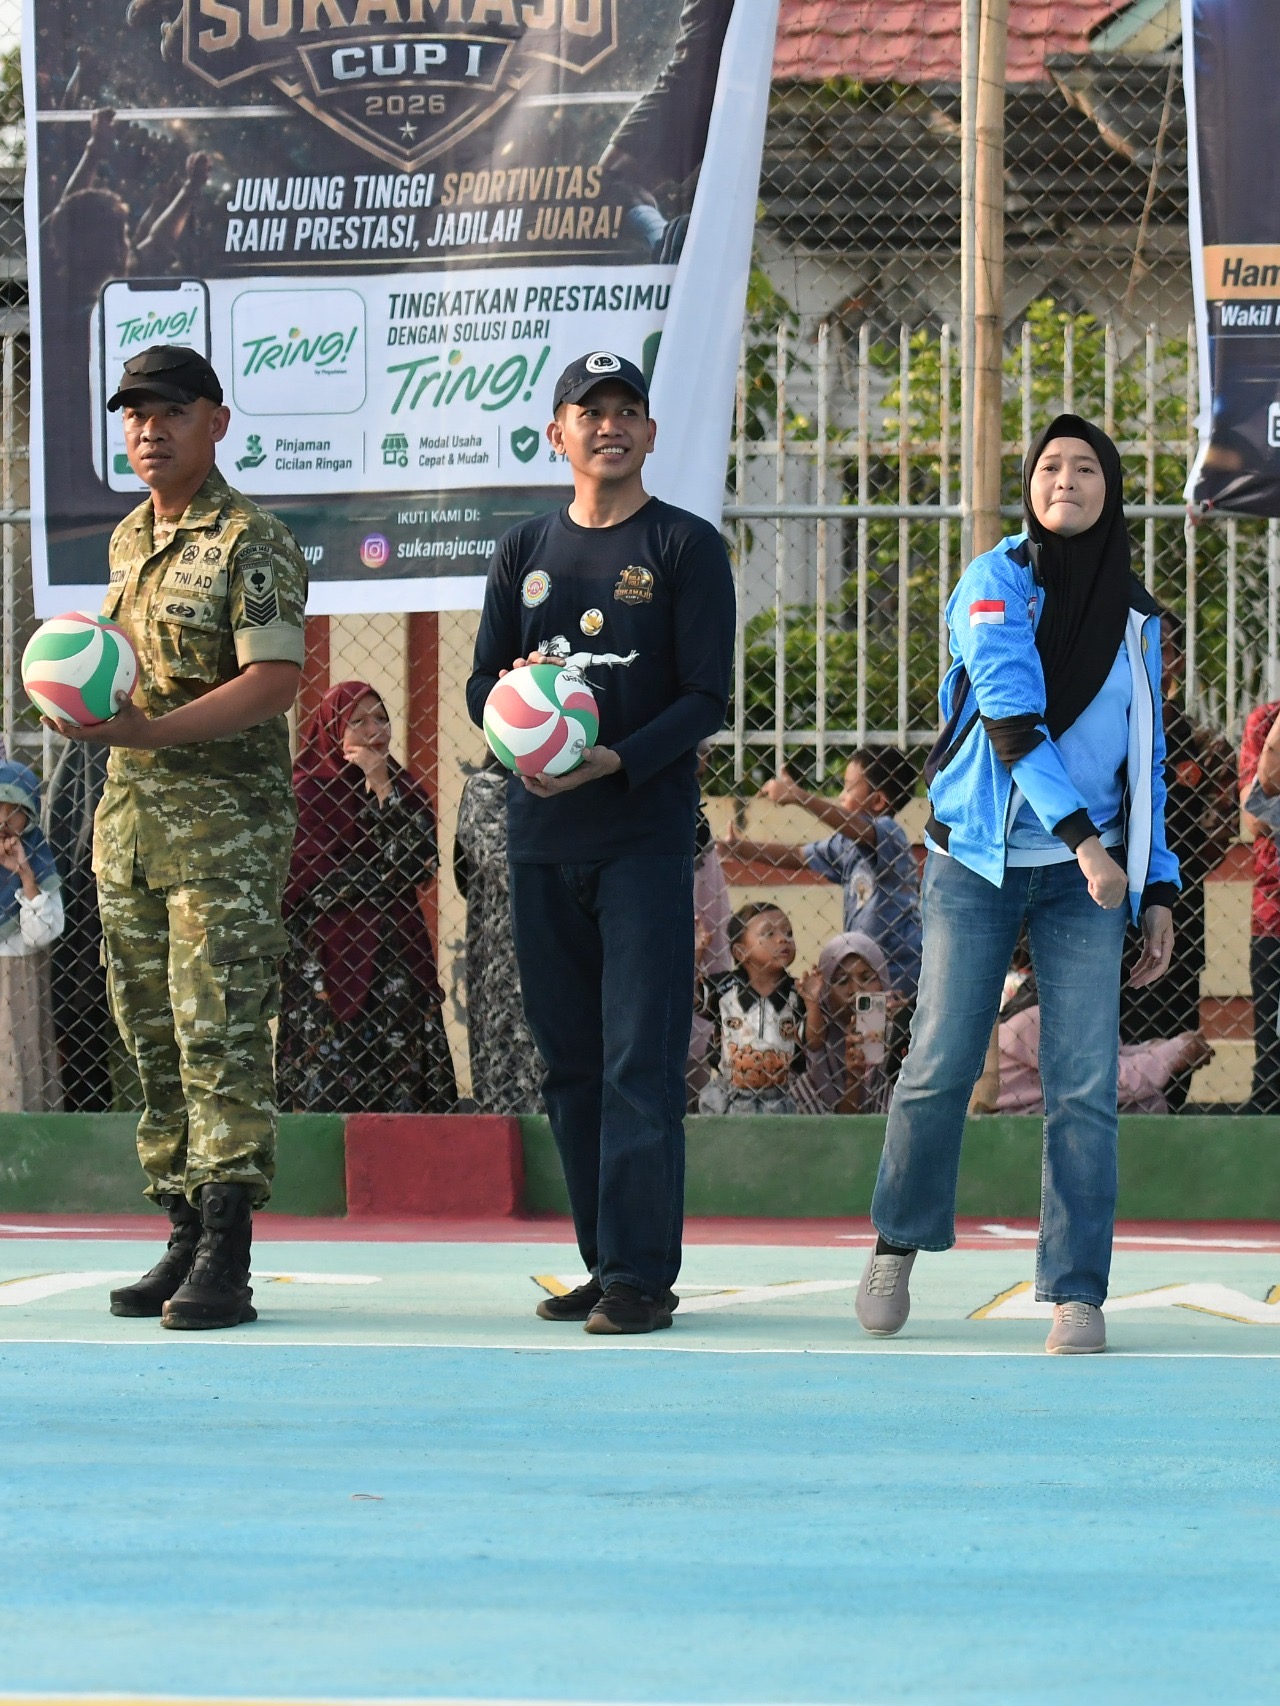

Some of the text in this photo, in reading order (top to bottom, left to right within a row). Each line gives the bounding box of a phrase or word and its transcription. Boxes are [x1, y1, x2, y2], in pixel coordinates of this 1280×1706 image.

[331, 43, 482, 80] CUP I
[365, 94, 445, 116] 2026
[226, 164, 603, 213] JUNJUNG TINGGI SPORTIVITAS
[224, 204, 623, 252] RAIH PRESTASI, JADILAH JUARA!
[388, 284, 671, 320] TINGKATKAN PRESTASIMU
[1220, 304, 1272, 328] Wakil
[387, 319, 551, 346] DENGAN SOLUSI DARI
[275, 438, 331, 454] Pinjaman
[419, 435, 482, 450] Modal Usaha
[275, 457, 353, 473] Cicilan Ringan
[418, 451, 489, 469] Cepat & Mudah
[549, 450, 557, 463] &
[397, 508, 481, 525] IKUTI KAMI DI:
[397, 535, 496, 560] sukamajucup
[174, 571, 213, 589] TNI AD
